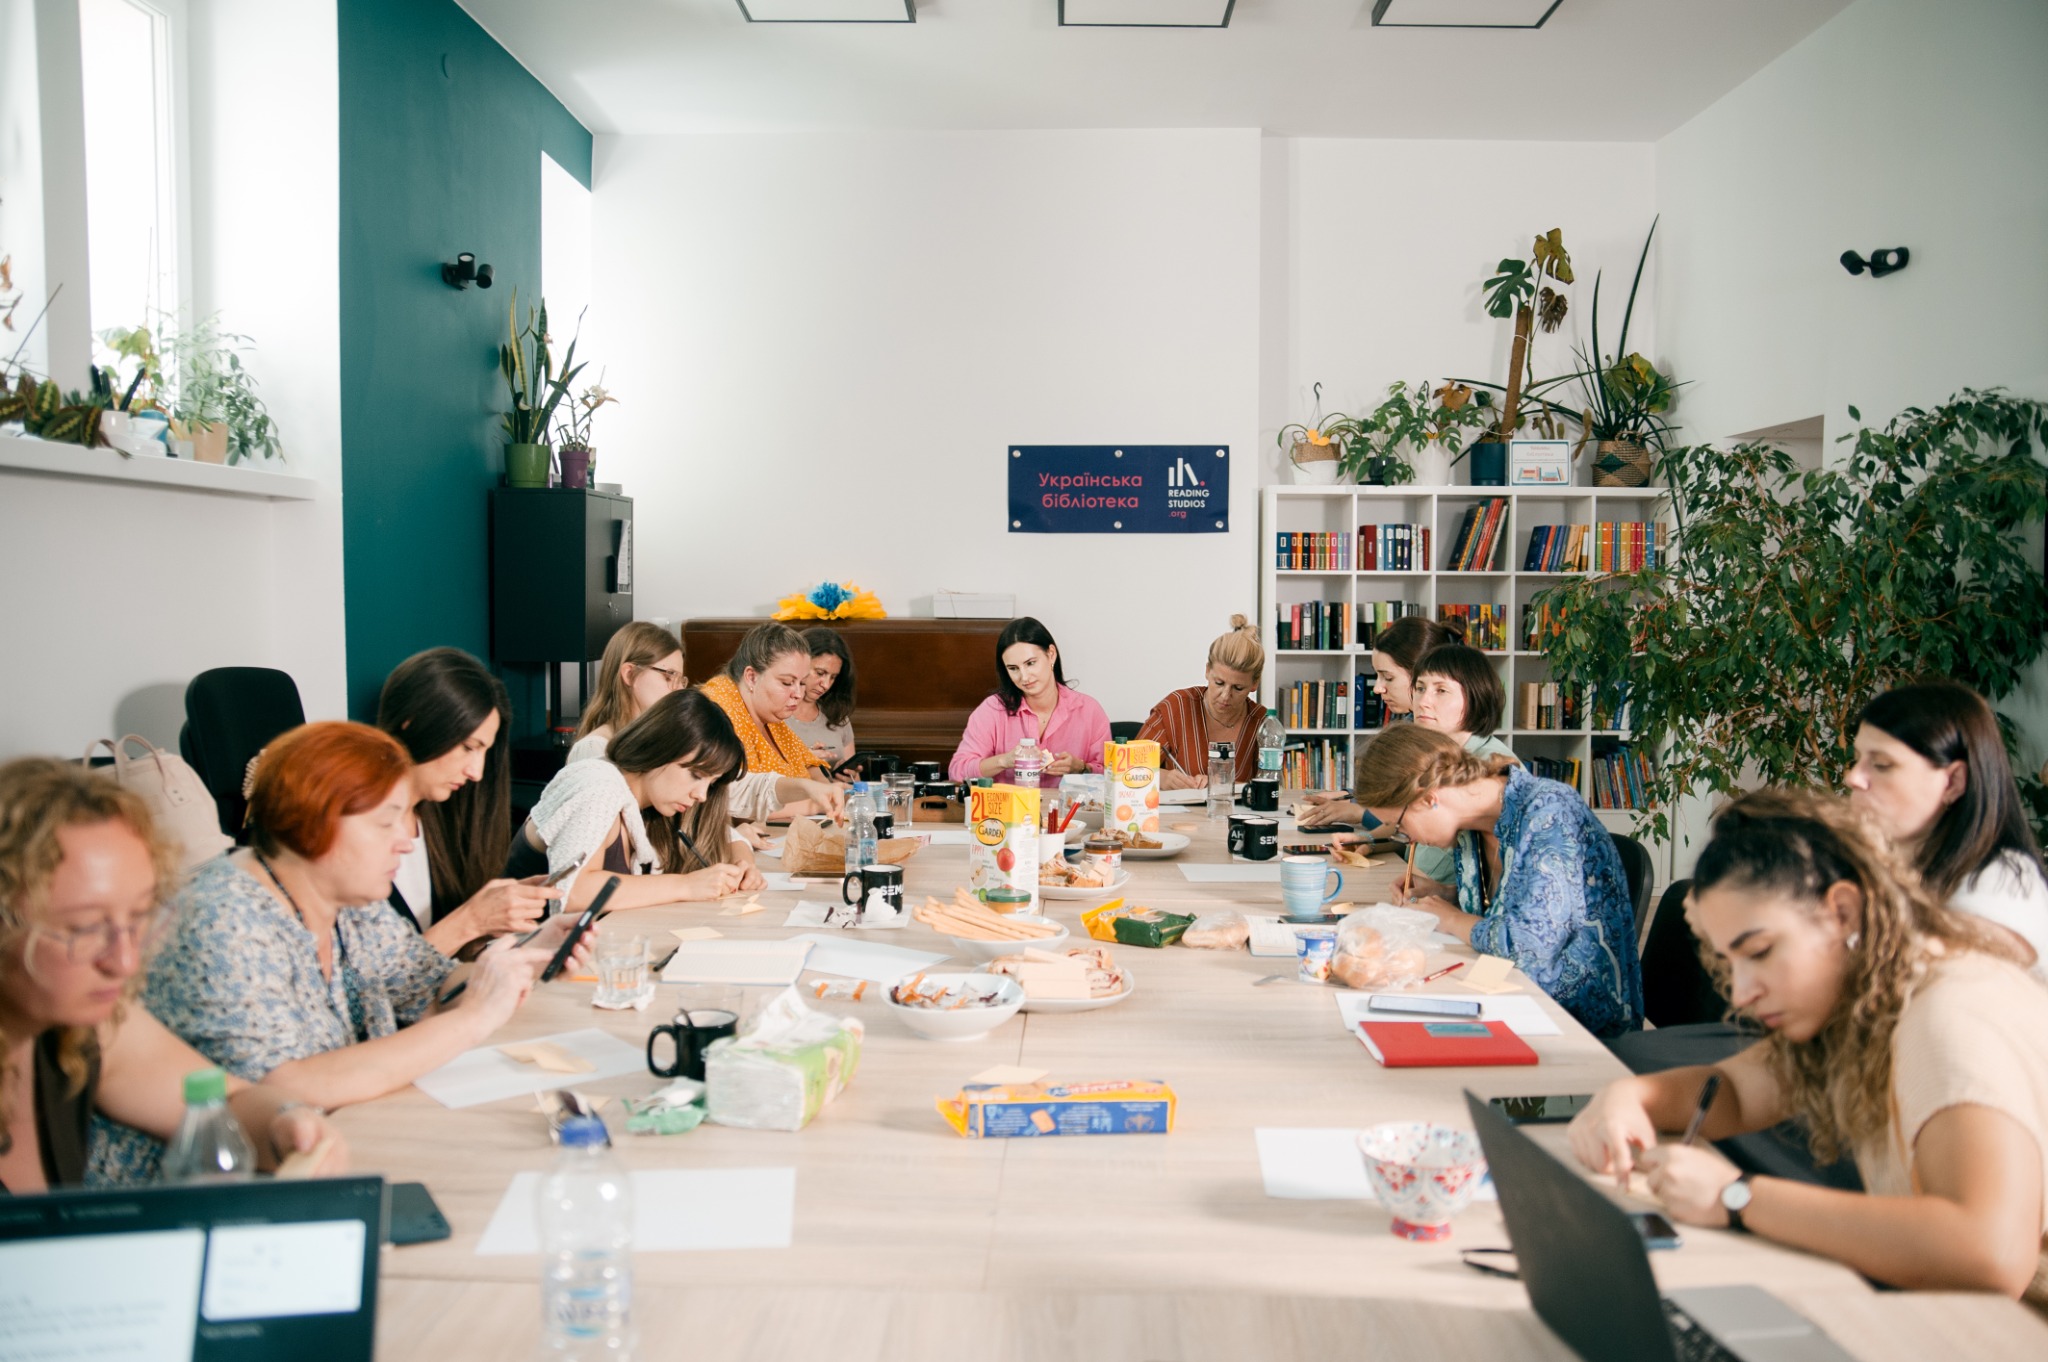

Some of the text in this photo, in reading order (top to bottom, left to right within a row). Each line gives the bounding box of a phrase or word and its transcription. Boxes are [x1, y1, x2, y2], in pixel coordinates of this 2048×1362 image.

[1039, 472, 1143, 490] Українська
[1168, 489, 1210, 498] READING
[1042, 493, 1139, 508] бібліотека
[1168, 500, 1206, 508] STUDIOS
[1168, 511, 1187, 519] .org
[1117, 747, 1134, 773] 2L
[1134, 754, 1148, 764] SIZE
[971, 791, 989, 822] 2L
[988, 802, 1002, 815] SIZE
[978, 824, 1004, 838] GARDEN
[880, 884, 904, 896] SEM
